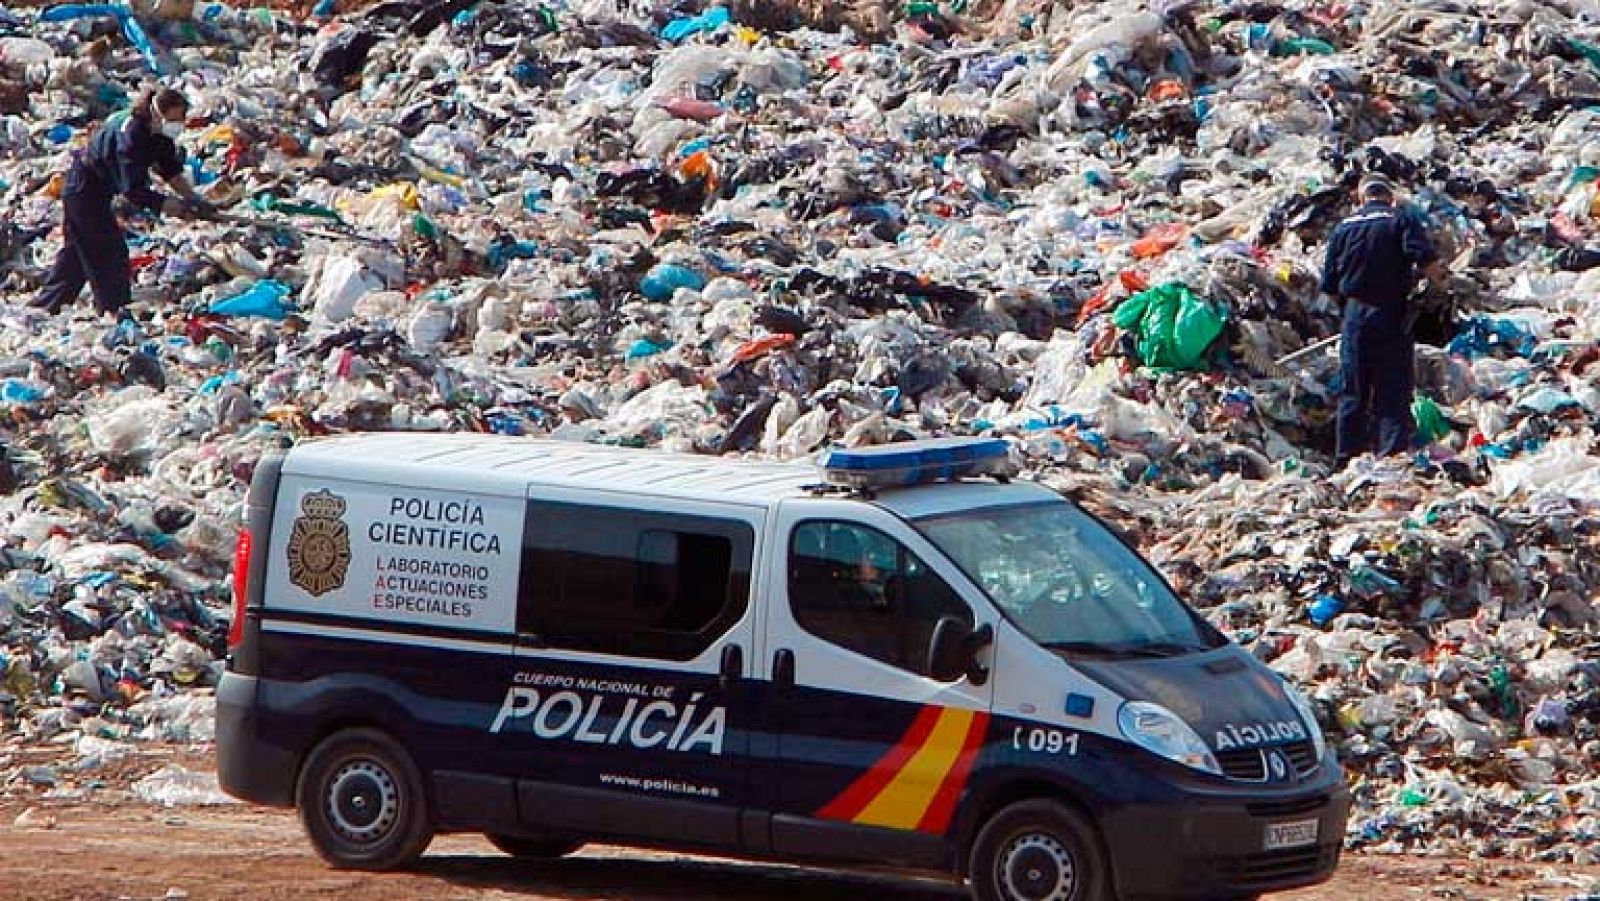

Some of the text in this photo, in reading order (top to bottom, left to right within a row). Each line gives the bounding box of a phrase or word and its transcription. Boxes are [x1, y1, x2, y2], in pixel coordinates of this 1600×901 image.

[390, 498, 484, 525] POLICÍA
[368, 521, 501, 554] CIENTÍFICA
[376, 555, 488, 580] LABORATORIO
[375, 576, 488, 599] ACTUACIONES
[374, 594, 472, 617] ESPECIALES
[513, 671, 676, 698] CUERPO NACIONAL DE
[489, 686, 726, 756] POLICÍA
[1028, 729, 1079, 756] 091
[599, 773, 720, 798] www.policia.es
